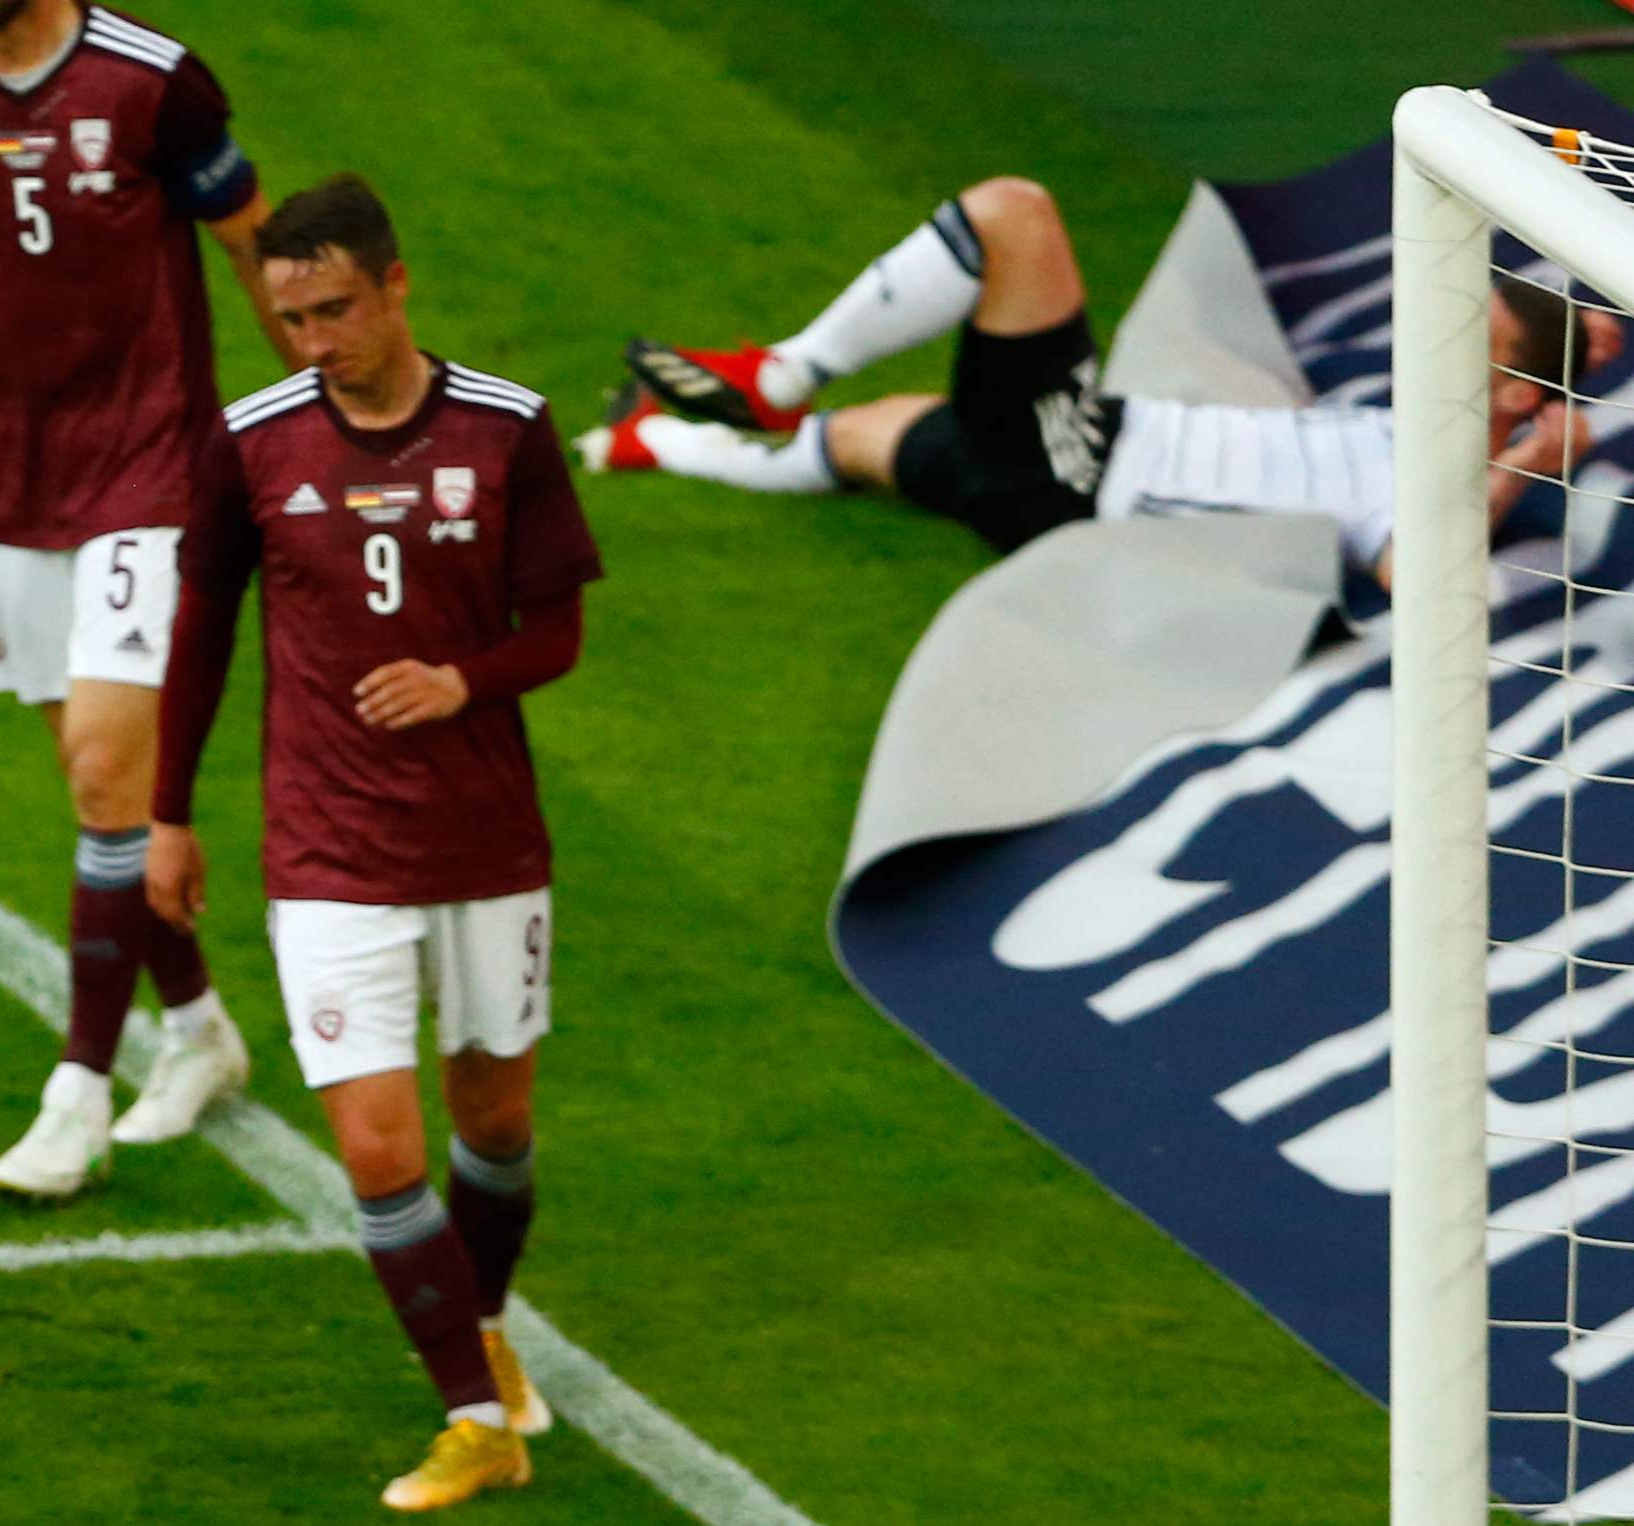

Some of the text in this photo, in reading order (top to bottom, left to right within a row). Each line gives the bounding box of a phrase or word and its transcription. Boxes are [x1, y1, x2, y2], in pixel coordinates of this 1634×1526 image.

[13, 176, 53, 255] 5
[107, 540, 139, 610] 5
[364, 532, 402, 615] 9
